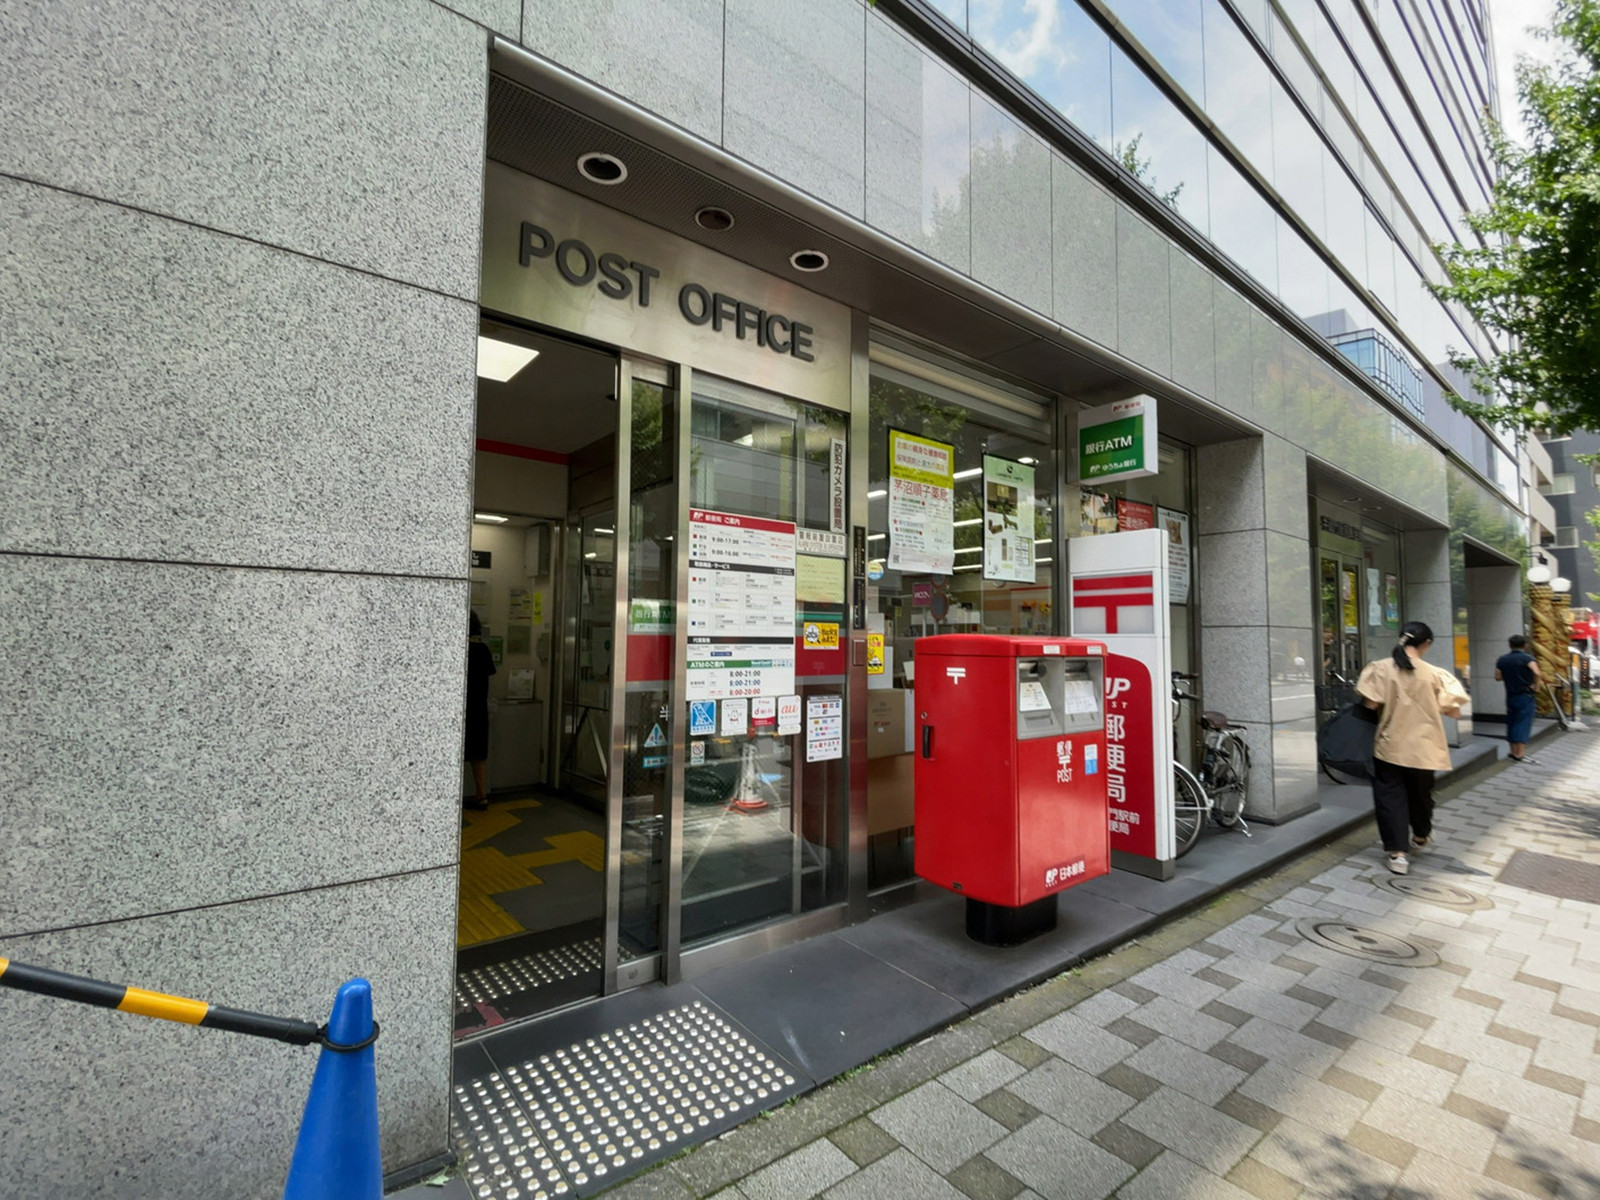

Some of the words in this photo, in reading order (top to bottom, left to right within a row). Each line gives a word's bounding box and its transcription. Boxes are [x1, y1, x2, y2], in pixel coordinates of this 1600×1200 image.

[519, 221, 660, 308] POST
[678, 283, 815, 363] OFFICE
[1085, 434, 1132, 455] 銀行ATM
[723, 516, 741, 526] ご案内
[729, 670, 761, 678] 8:00-21:00
[729, 679, 761, 687] 8:00-21:00
[781, 704, 797, 715] au
[1111, 701, 1129, 709] ST
[1057, 768, 1073, 784] POST
